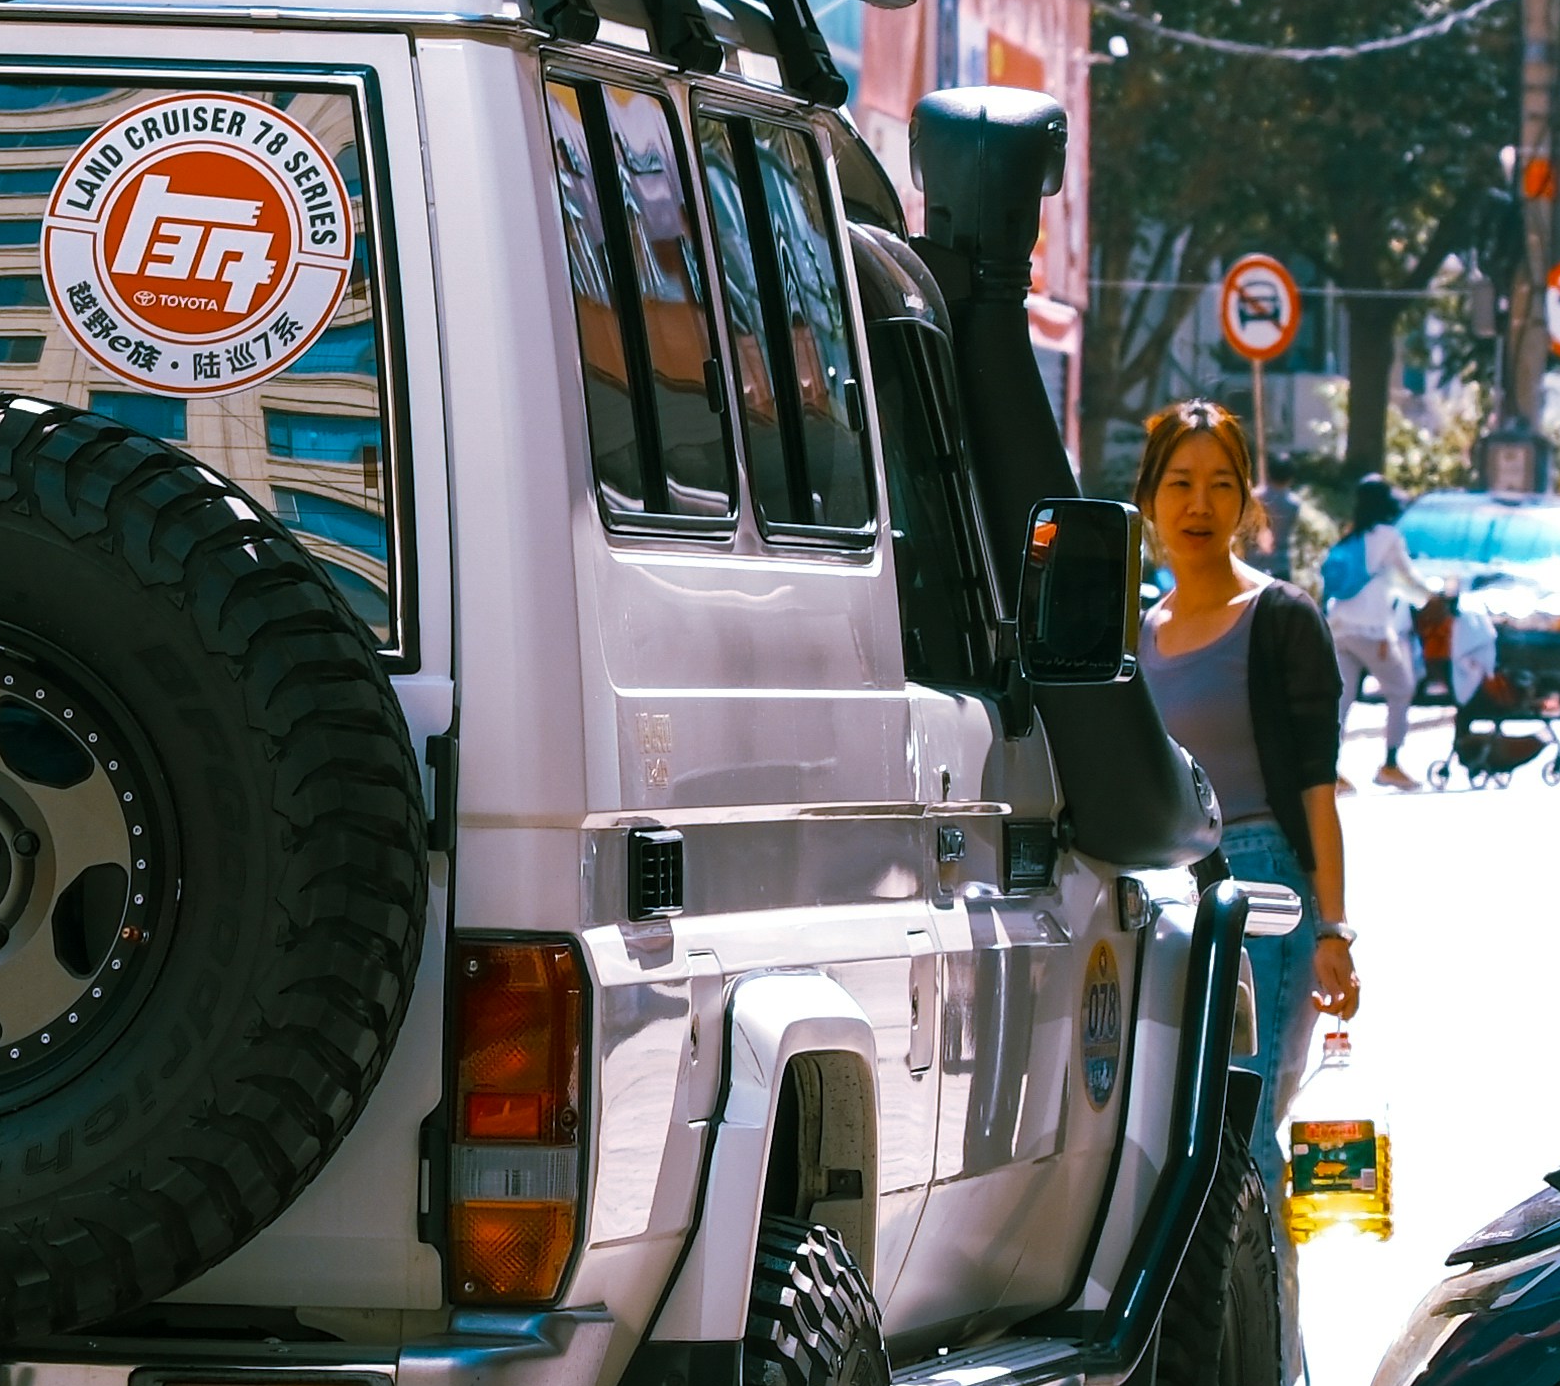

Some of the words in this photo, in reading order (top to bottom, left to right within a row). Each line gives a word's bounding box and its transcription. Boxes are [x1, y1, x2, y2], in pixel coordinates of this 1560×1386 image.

[66, 142, 124, 213] LAND
[123, 105, 248, 152] CRUISER
[250, 119, 290, 157] 78
[284, 149, 339, 247] SERIES
[158, 293, 219, 313] TOYOTA
[1088, 981, 1117, 1041] 078
